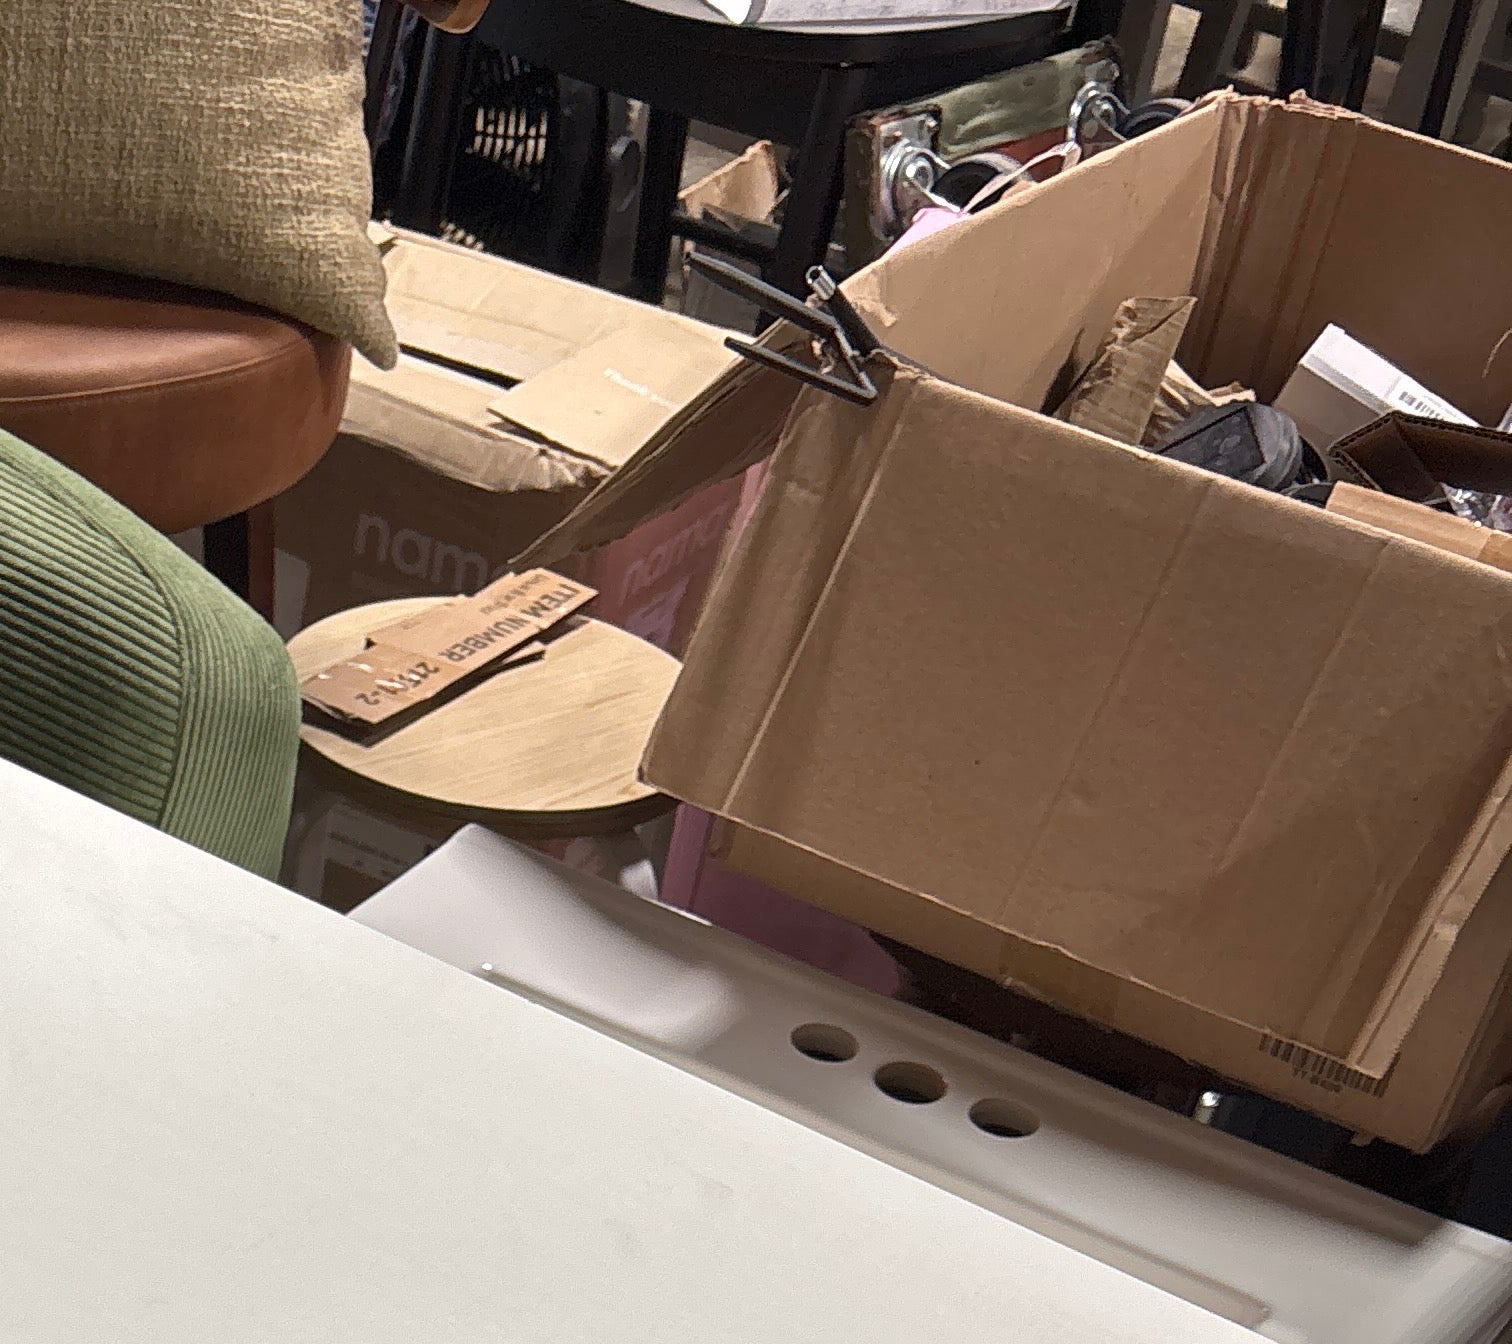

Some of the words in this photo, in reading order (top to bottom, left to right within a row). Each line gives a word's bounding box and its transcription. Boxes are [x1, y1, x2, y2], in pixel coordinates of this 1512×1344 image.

[353, 512, 506, 592] nam
[521, 582, 581, 619] ITEM
[438, 616, 529, 662] NUMBER
